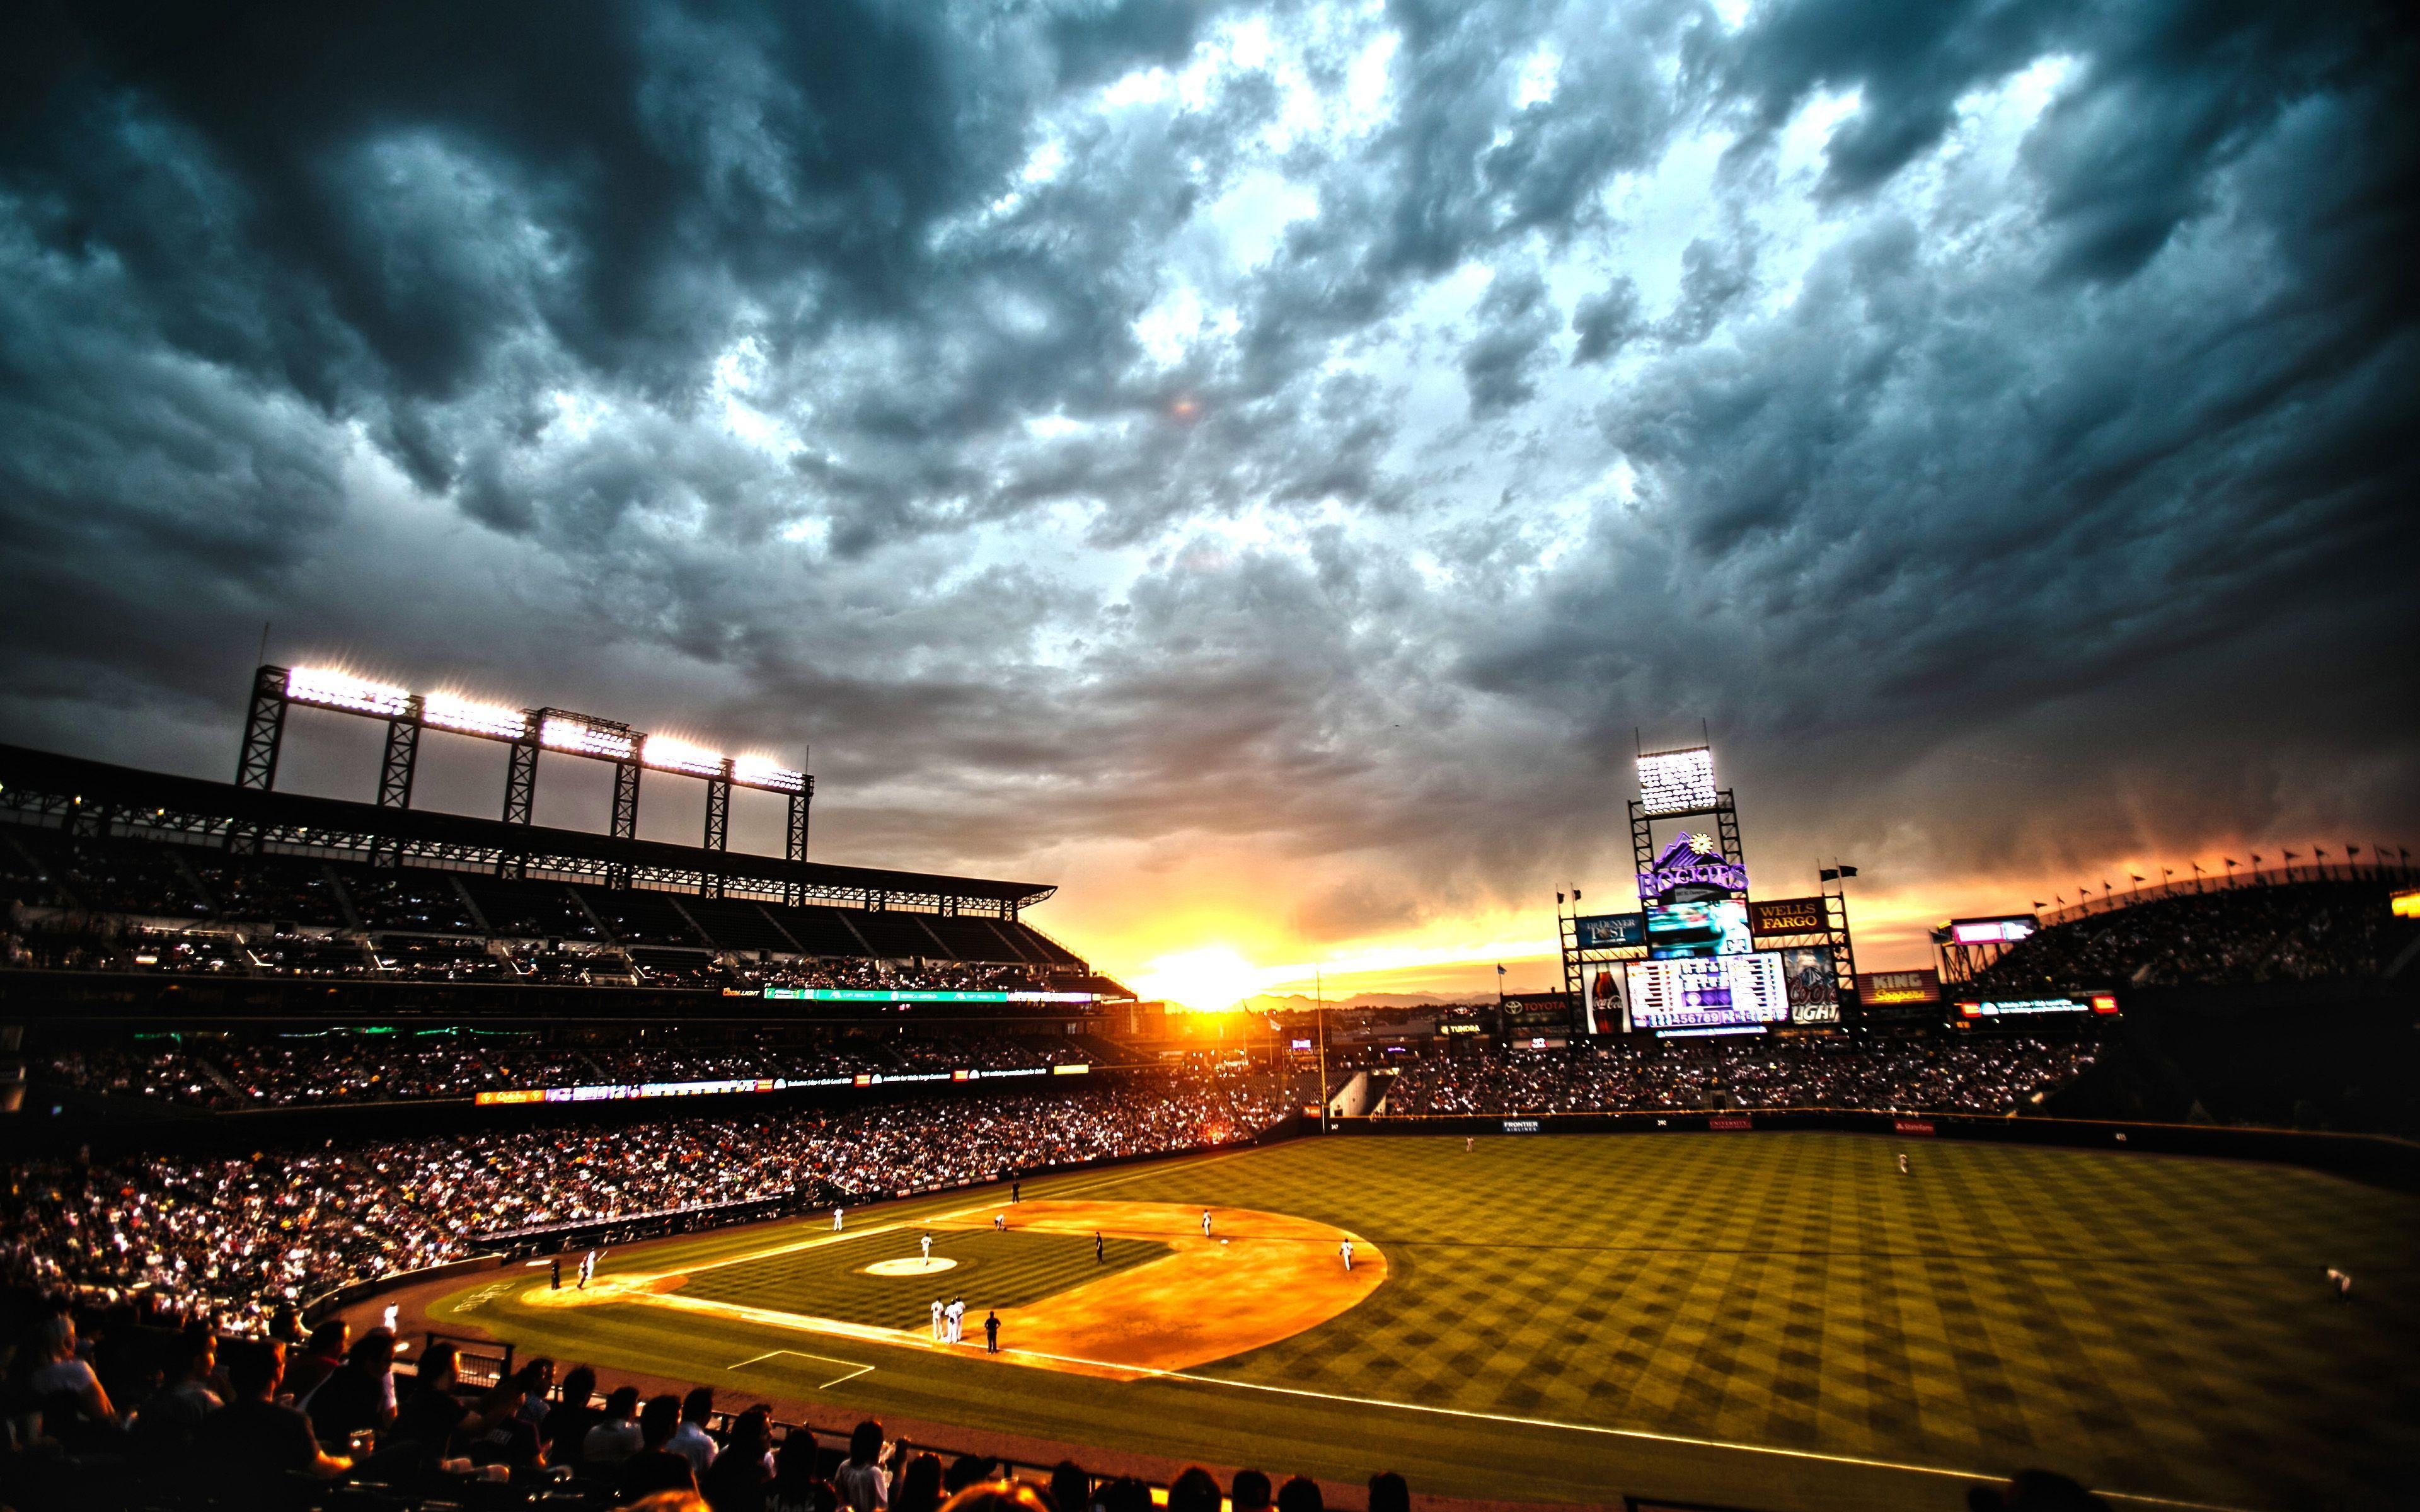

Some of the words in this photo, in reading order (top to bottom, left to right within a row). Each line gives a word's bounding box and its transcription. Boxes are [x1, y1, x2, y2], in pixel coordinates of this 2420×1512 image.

[1636, 864, 1749, 898] ROCKIES
[1760, 903, 1816, 917] WELLS
[1763, 915, 1817, 929] FARGO
[1872, 974, 1922, 989] KING
[1524, 1001, 1566, 1011] TOYOTA
[1792, 1004, 1839, 1021] LIGHT
[1451, 1025, 1480, 1033] TUNDRA
